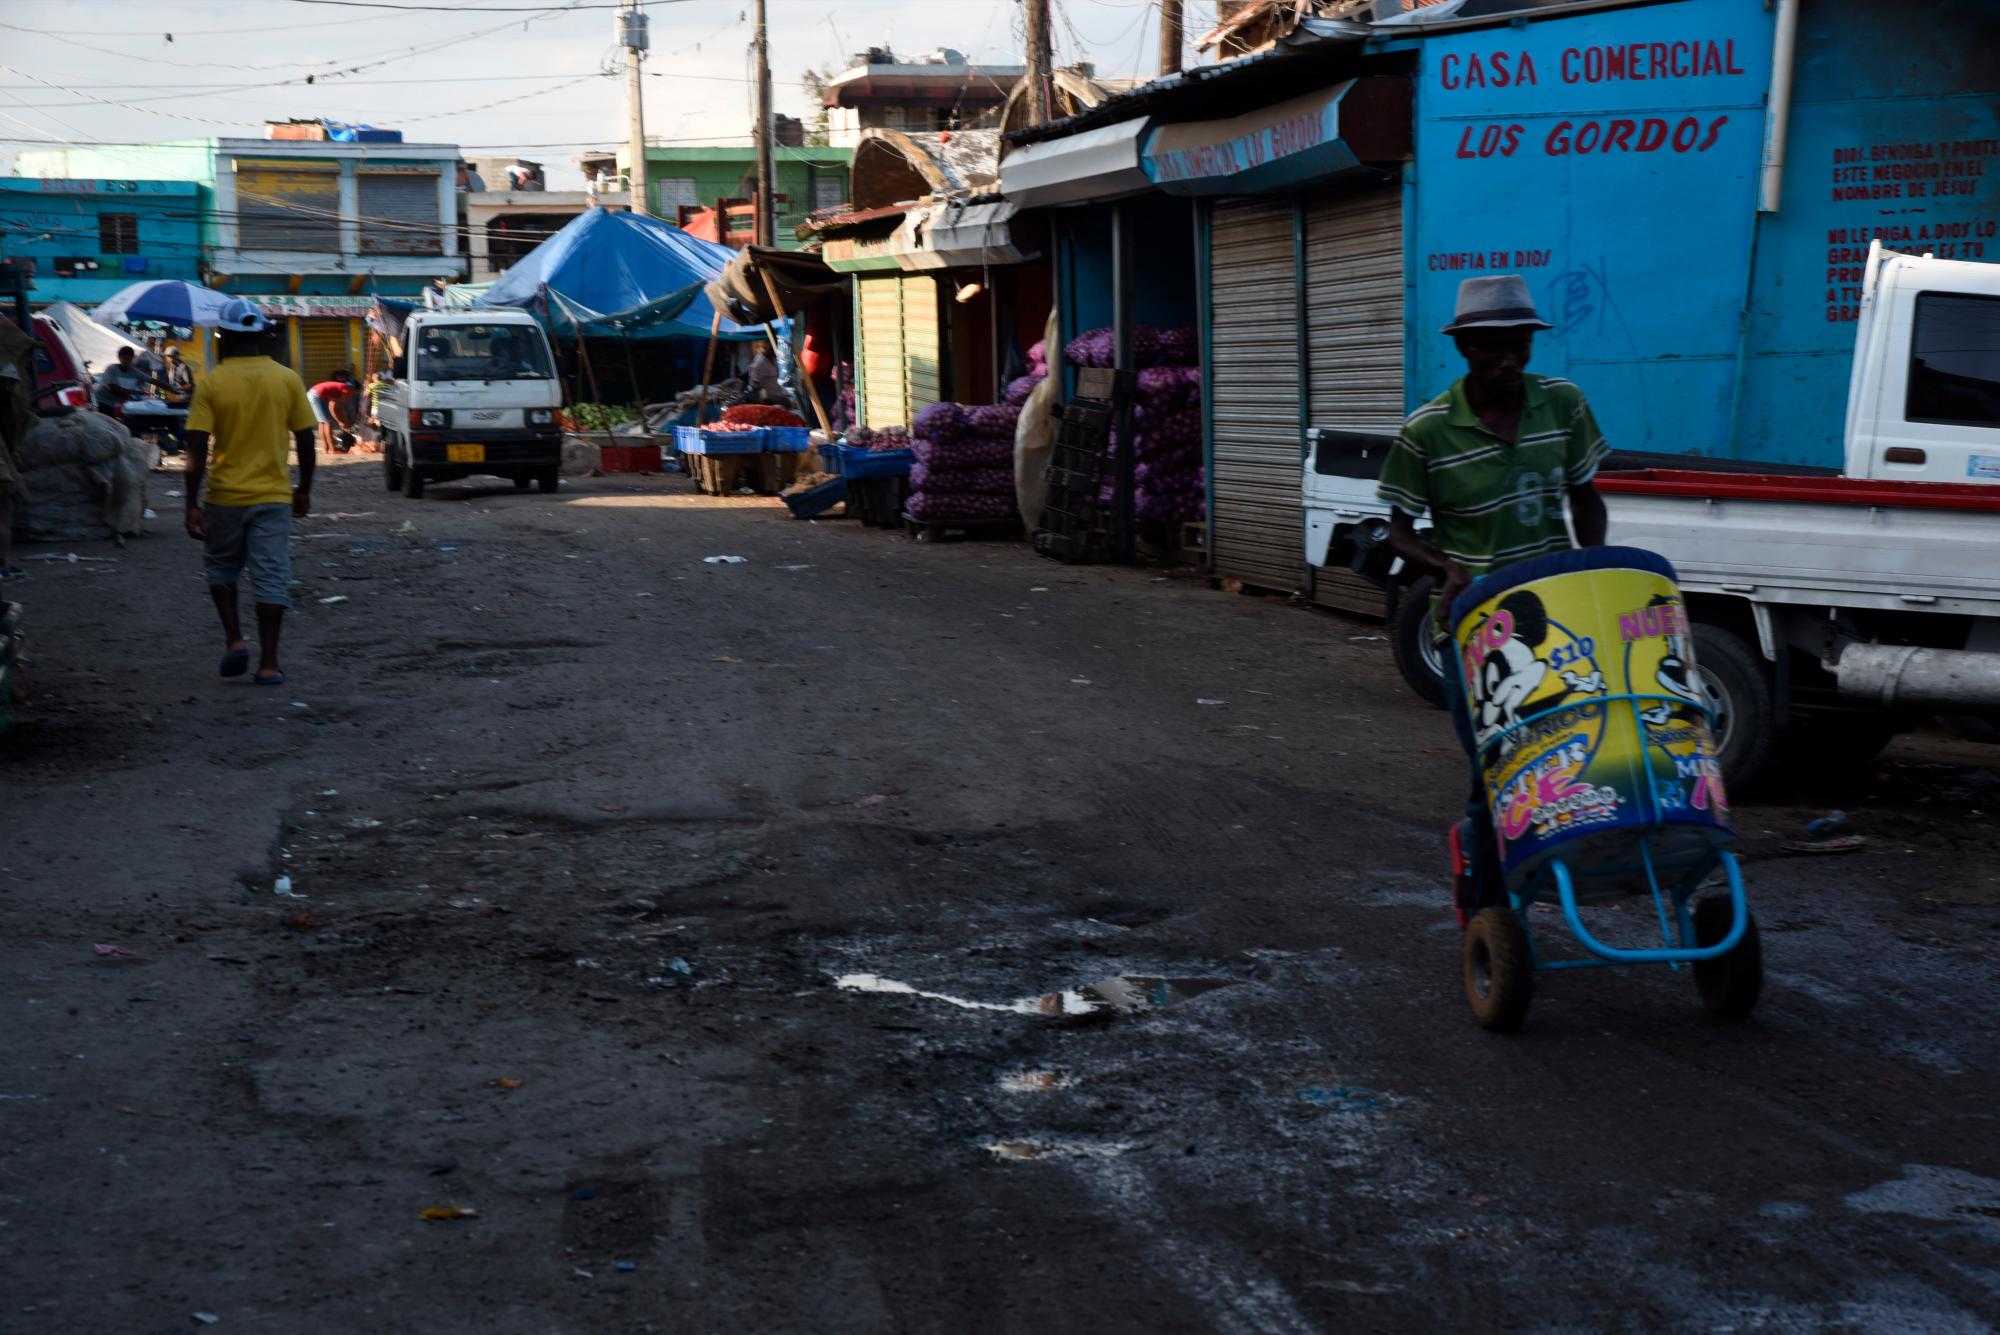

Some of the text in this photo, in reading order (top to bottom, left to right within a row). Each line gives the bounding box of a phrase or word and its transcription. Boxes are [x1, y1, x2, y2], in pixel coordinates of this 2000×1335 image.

[1440, 39, 1745, 91] CASA COMERCIAL
[1456, 114, 1728, 159] LOS GORDOS
[1833, 166, 1868, 183] ESTE
[1873, 163, 1939, 181] NEGOCIO
[1833, 180, 1977, 202] NOMBRE DE JESUS
[1828, 228, 1847, 244] NO
[1851, 227, 1869, 243] LE
[1429, 249, 1552, 272] CONFIA EN DIOS
[1550, 636, 1595, 671] $10
